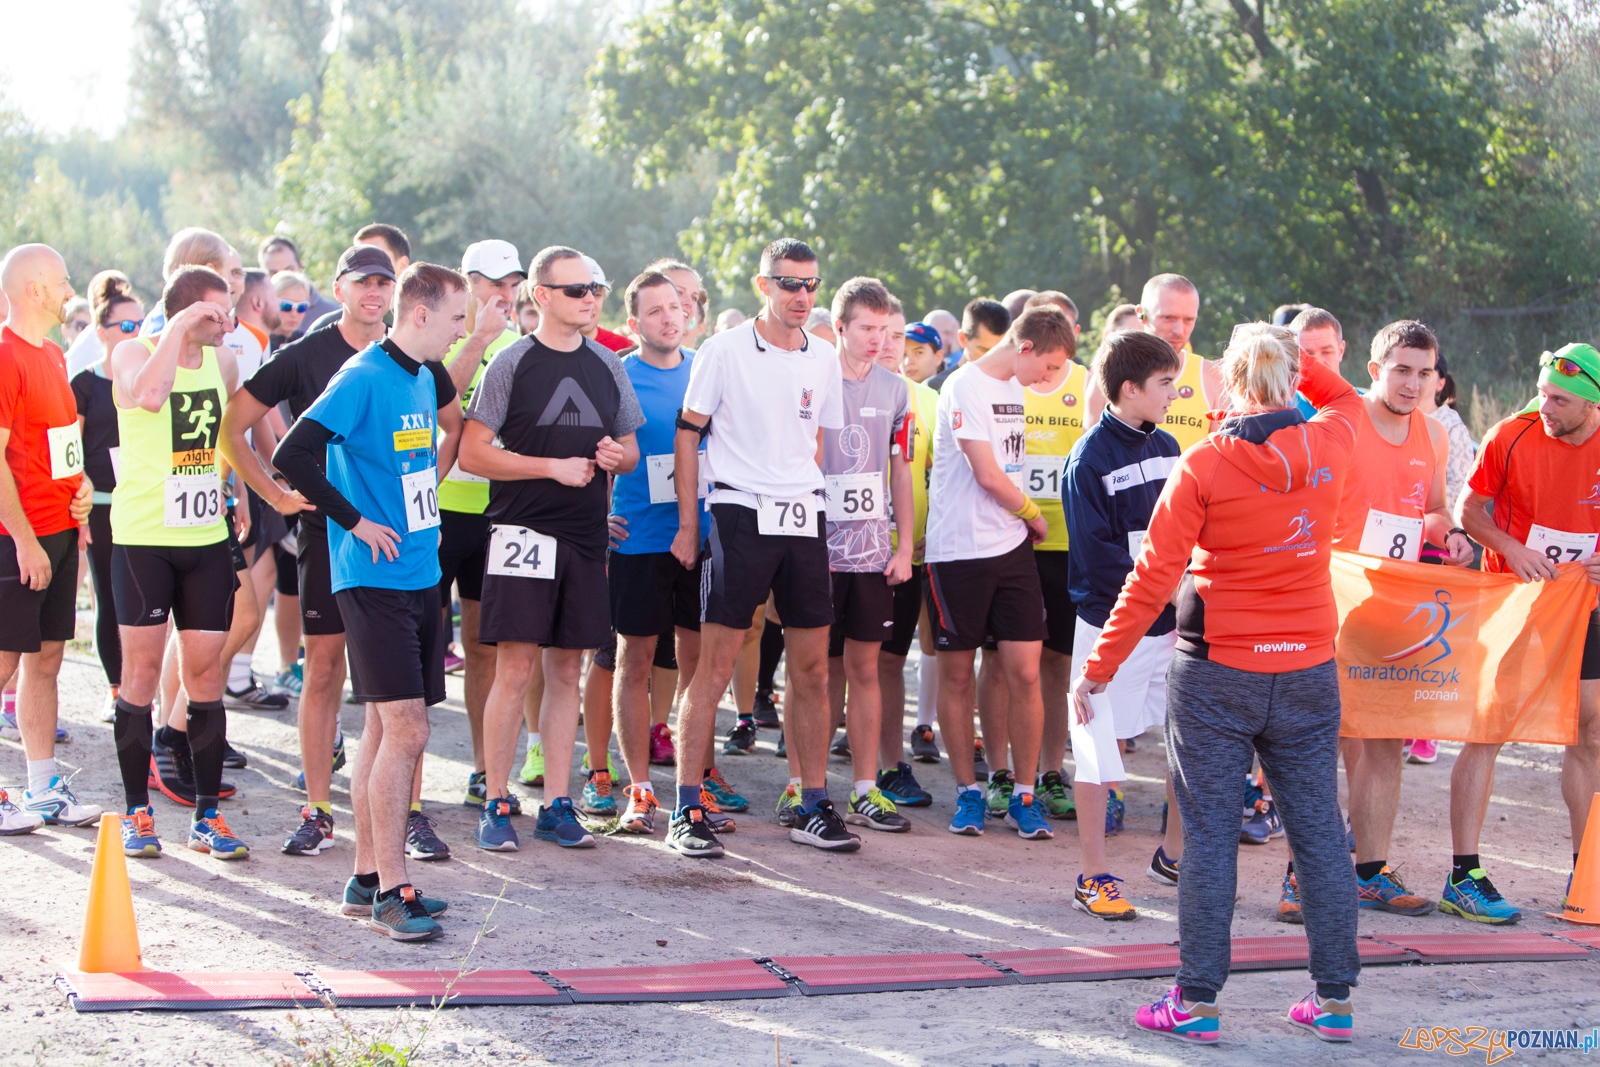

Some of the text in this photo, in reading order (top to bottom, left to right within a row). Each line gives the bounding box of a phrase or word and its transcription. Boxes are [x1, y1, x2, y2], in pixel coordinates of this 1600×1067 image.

[1166, 414, 1203, 429] BIEGA
[1028, 468, 1059, 493] 51
[174, 488, 219, 519] 103
[842, 487, 875, 514] 58
[774, 501, 808, 529] 79
[502, 541, 543, 571] 24
[1388, 532, 1408, 560] 8
[1253, 641, 1307, 653] newline
[1347, 663, 1460, 688] maratończyk
[1414, 687, 1459, 703] poznań
